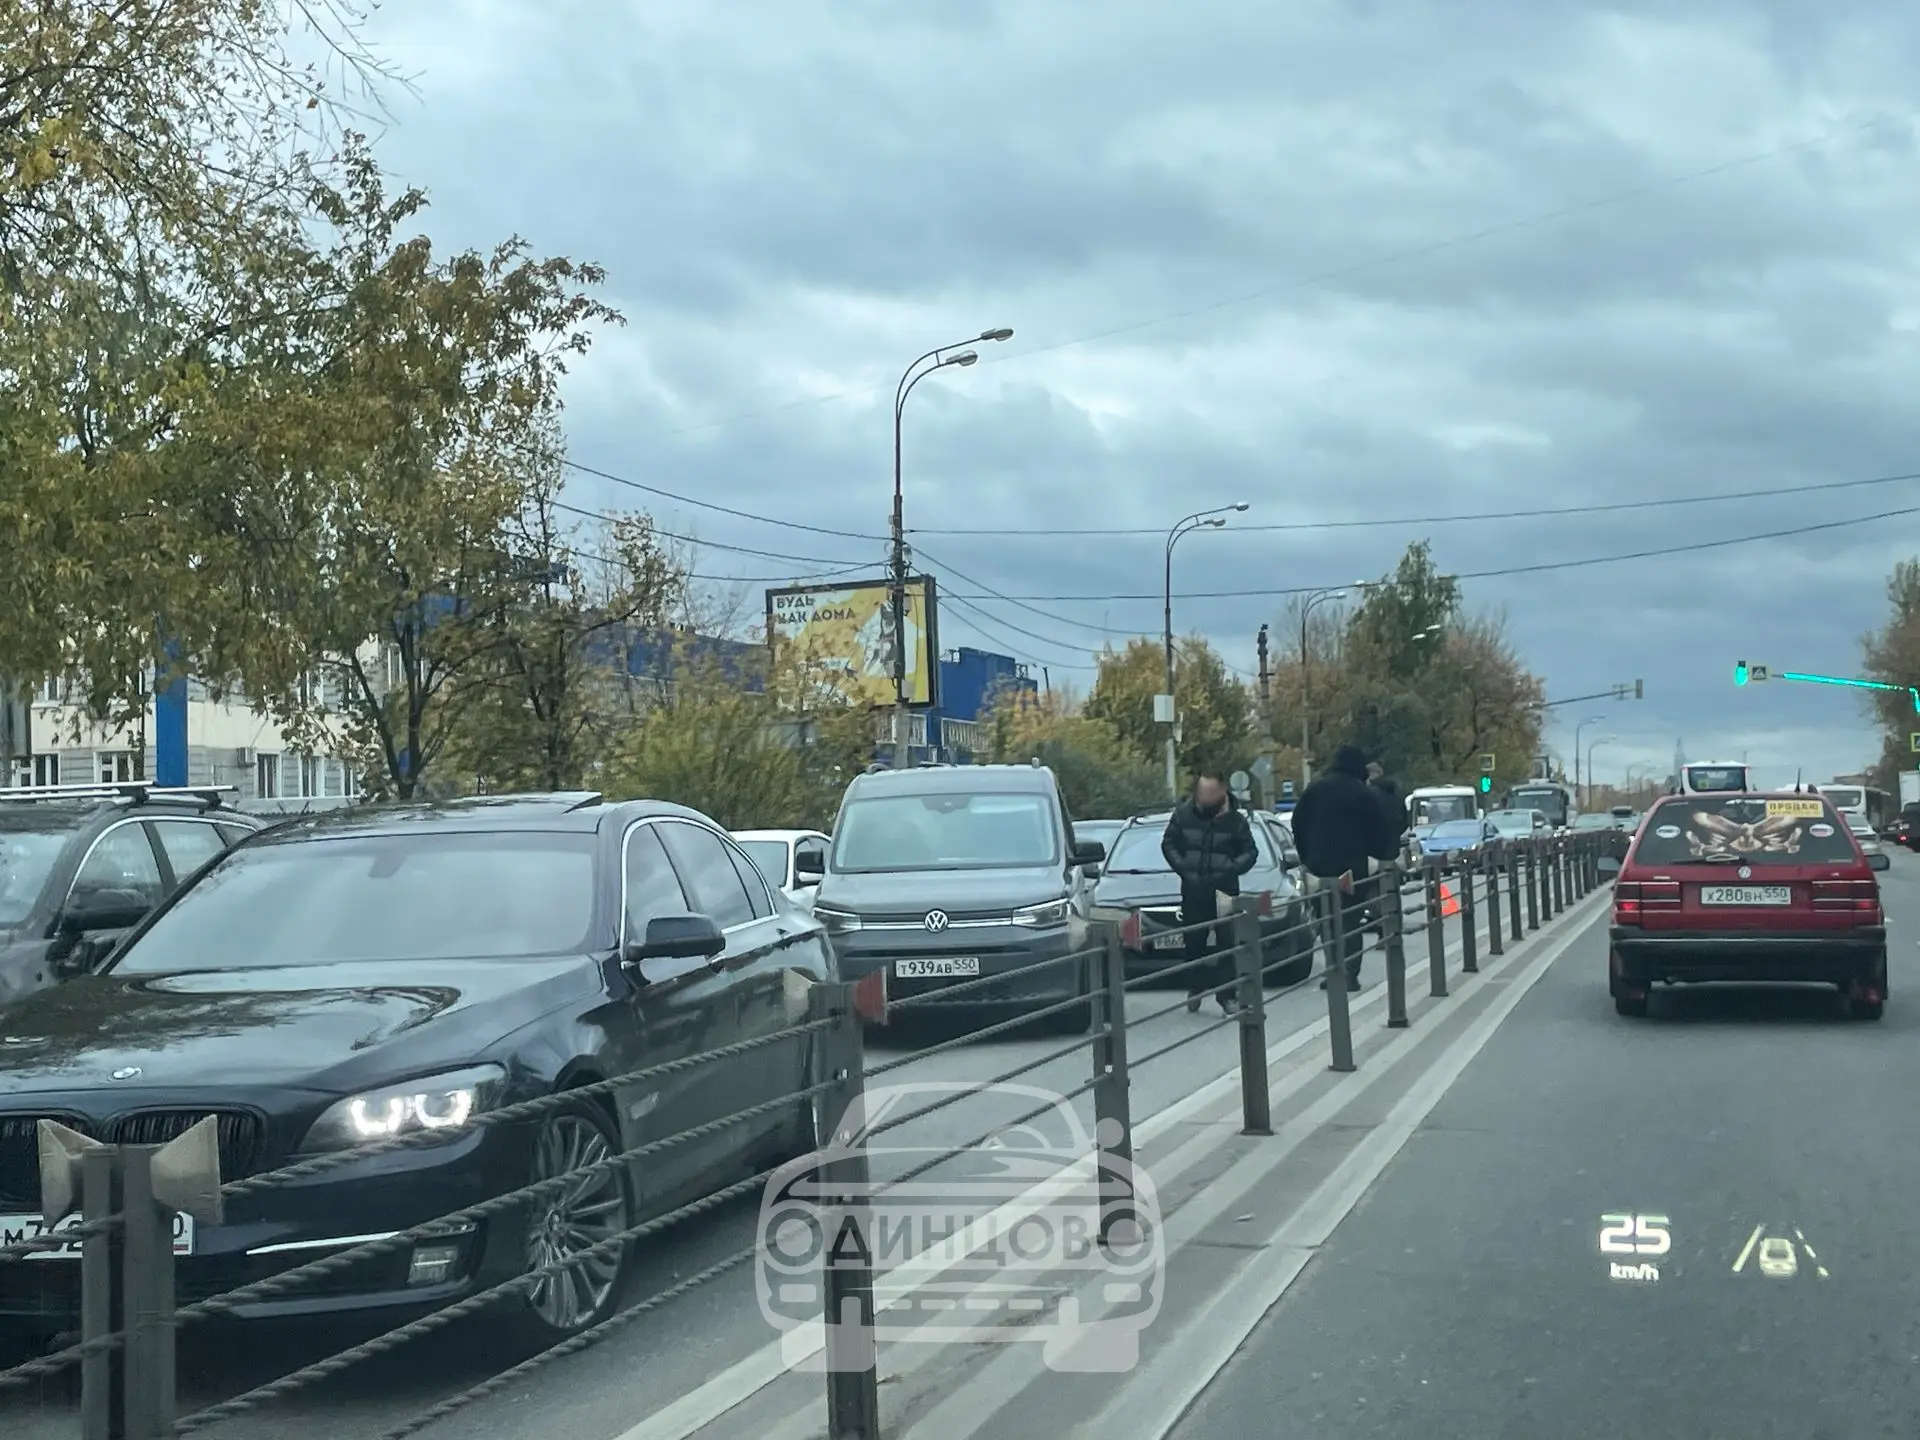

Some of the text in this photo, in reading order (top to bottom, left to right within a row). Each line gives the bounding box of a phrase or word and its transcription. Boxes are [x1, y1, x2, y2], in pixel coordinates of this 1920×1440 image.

[777, 595, 815, 609] БУДЬ
[777, 607, 857, 625] КАК ДОМА
[1599, 1214, 1671, 1256] 25
[1609, 1261, 1660, 1282] km/h
